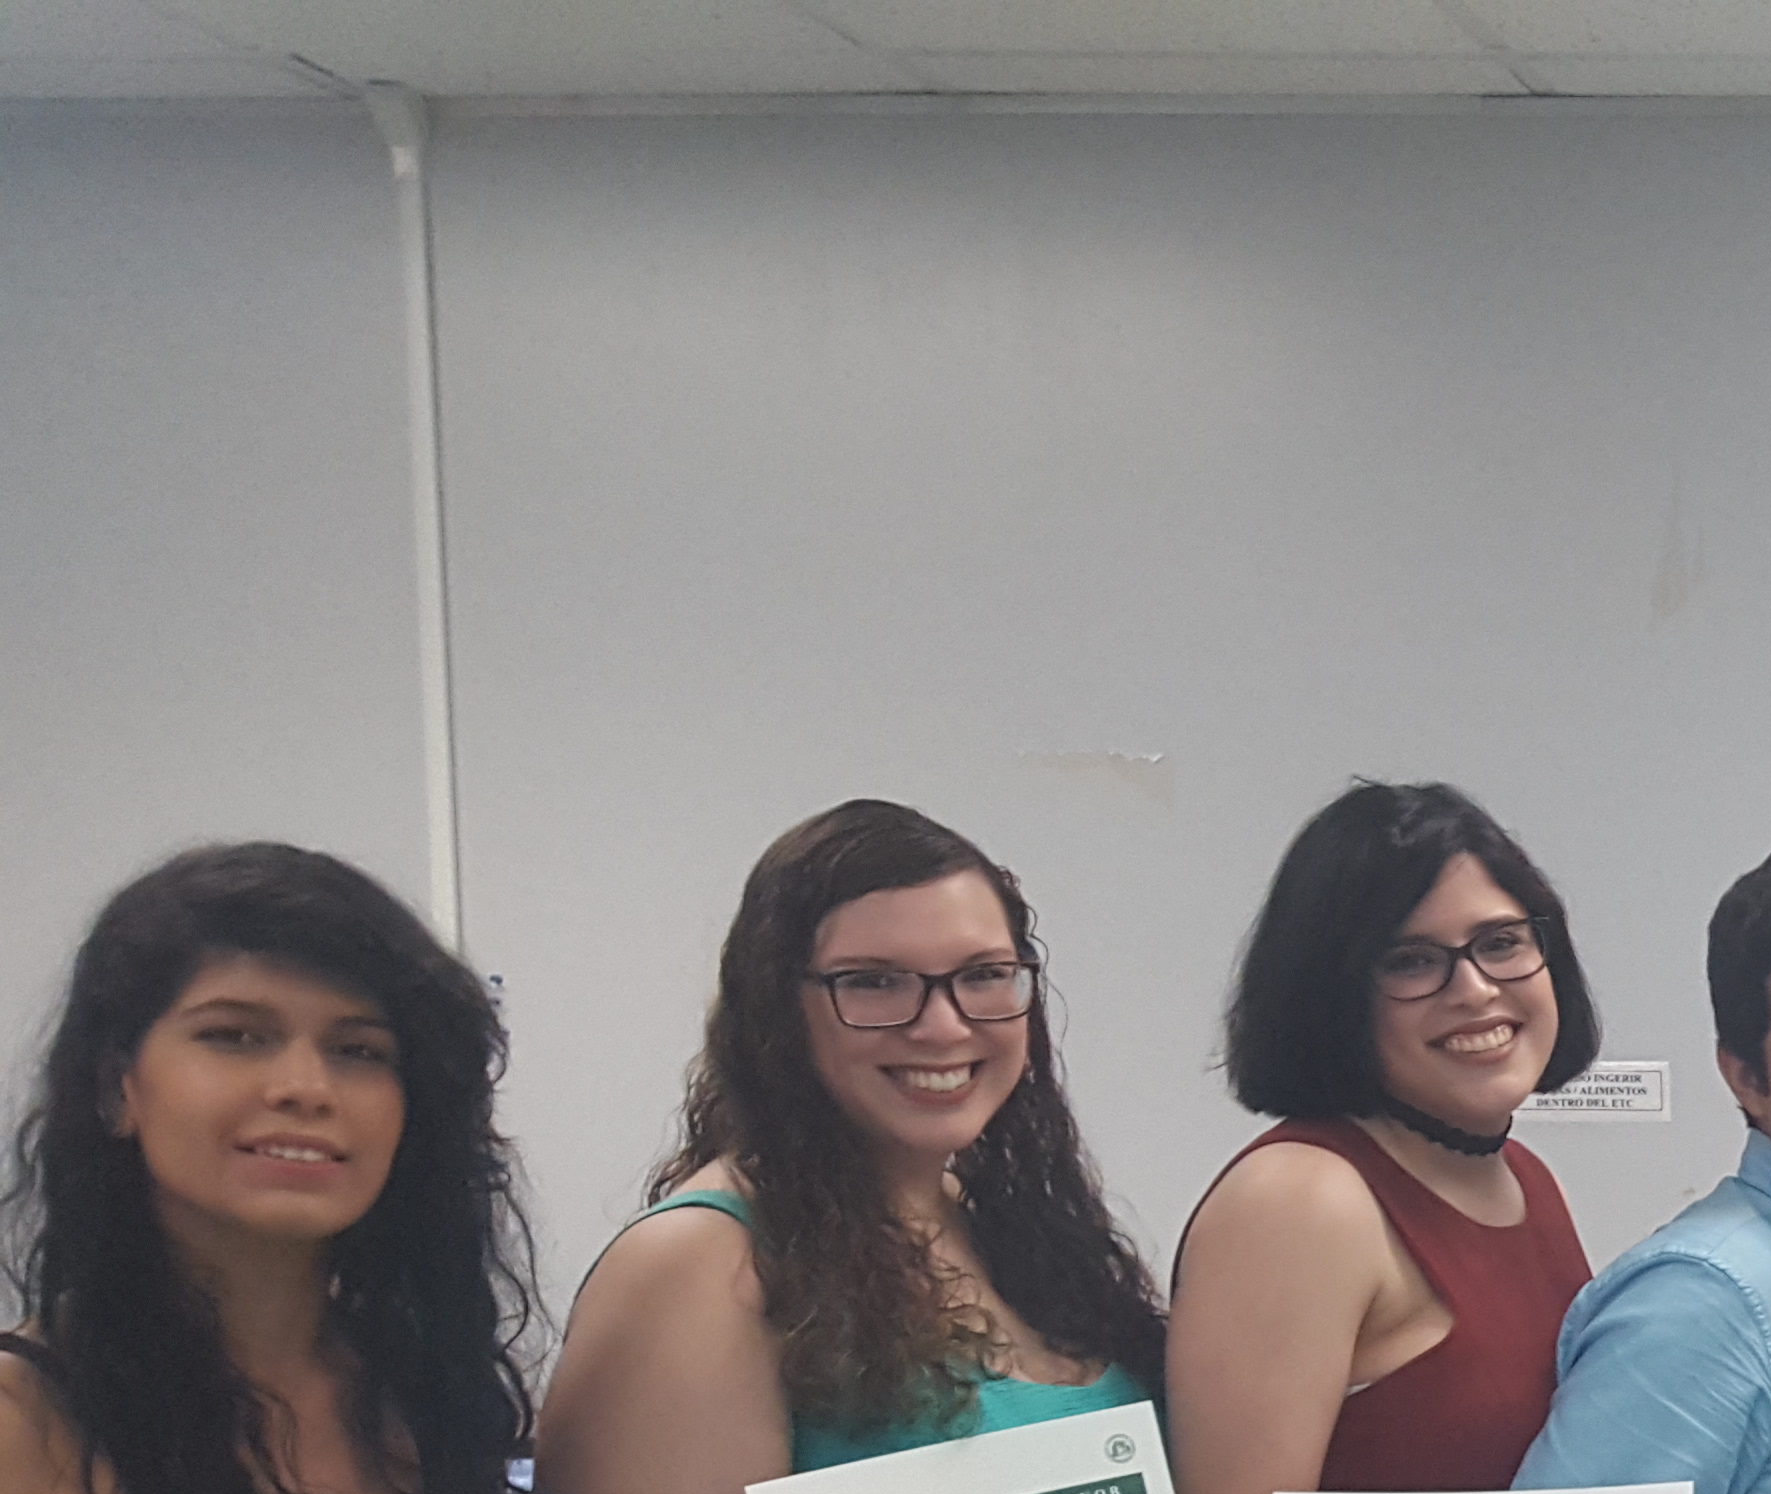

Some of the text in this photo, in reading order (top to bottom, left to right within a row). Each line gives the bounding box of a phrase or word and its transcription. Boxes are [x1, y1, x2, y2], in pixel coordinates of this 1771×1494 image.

[1594, 1074, 1642, 1083] INGERIR
[1580, 1087, 1647, 1095] ALIMENTOS
[1536, 1099, 1583, 1107] DENTRO
